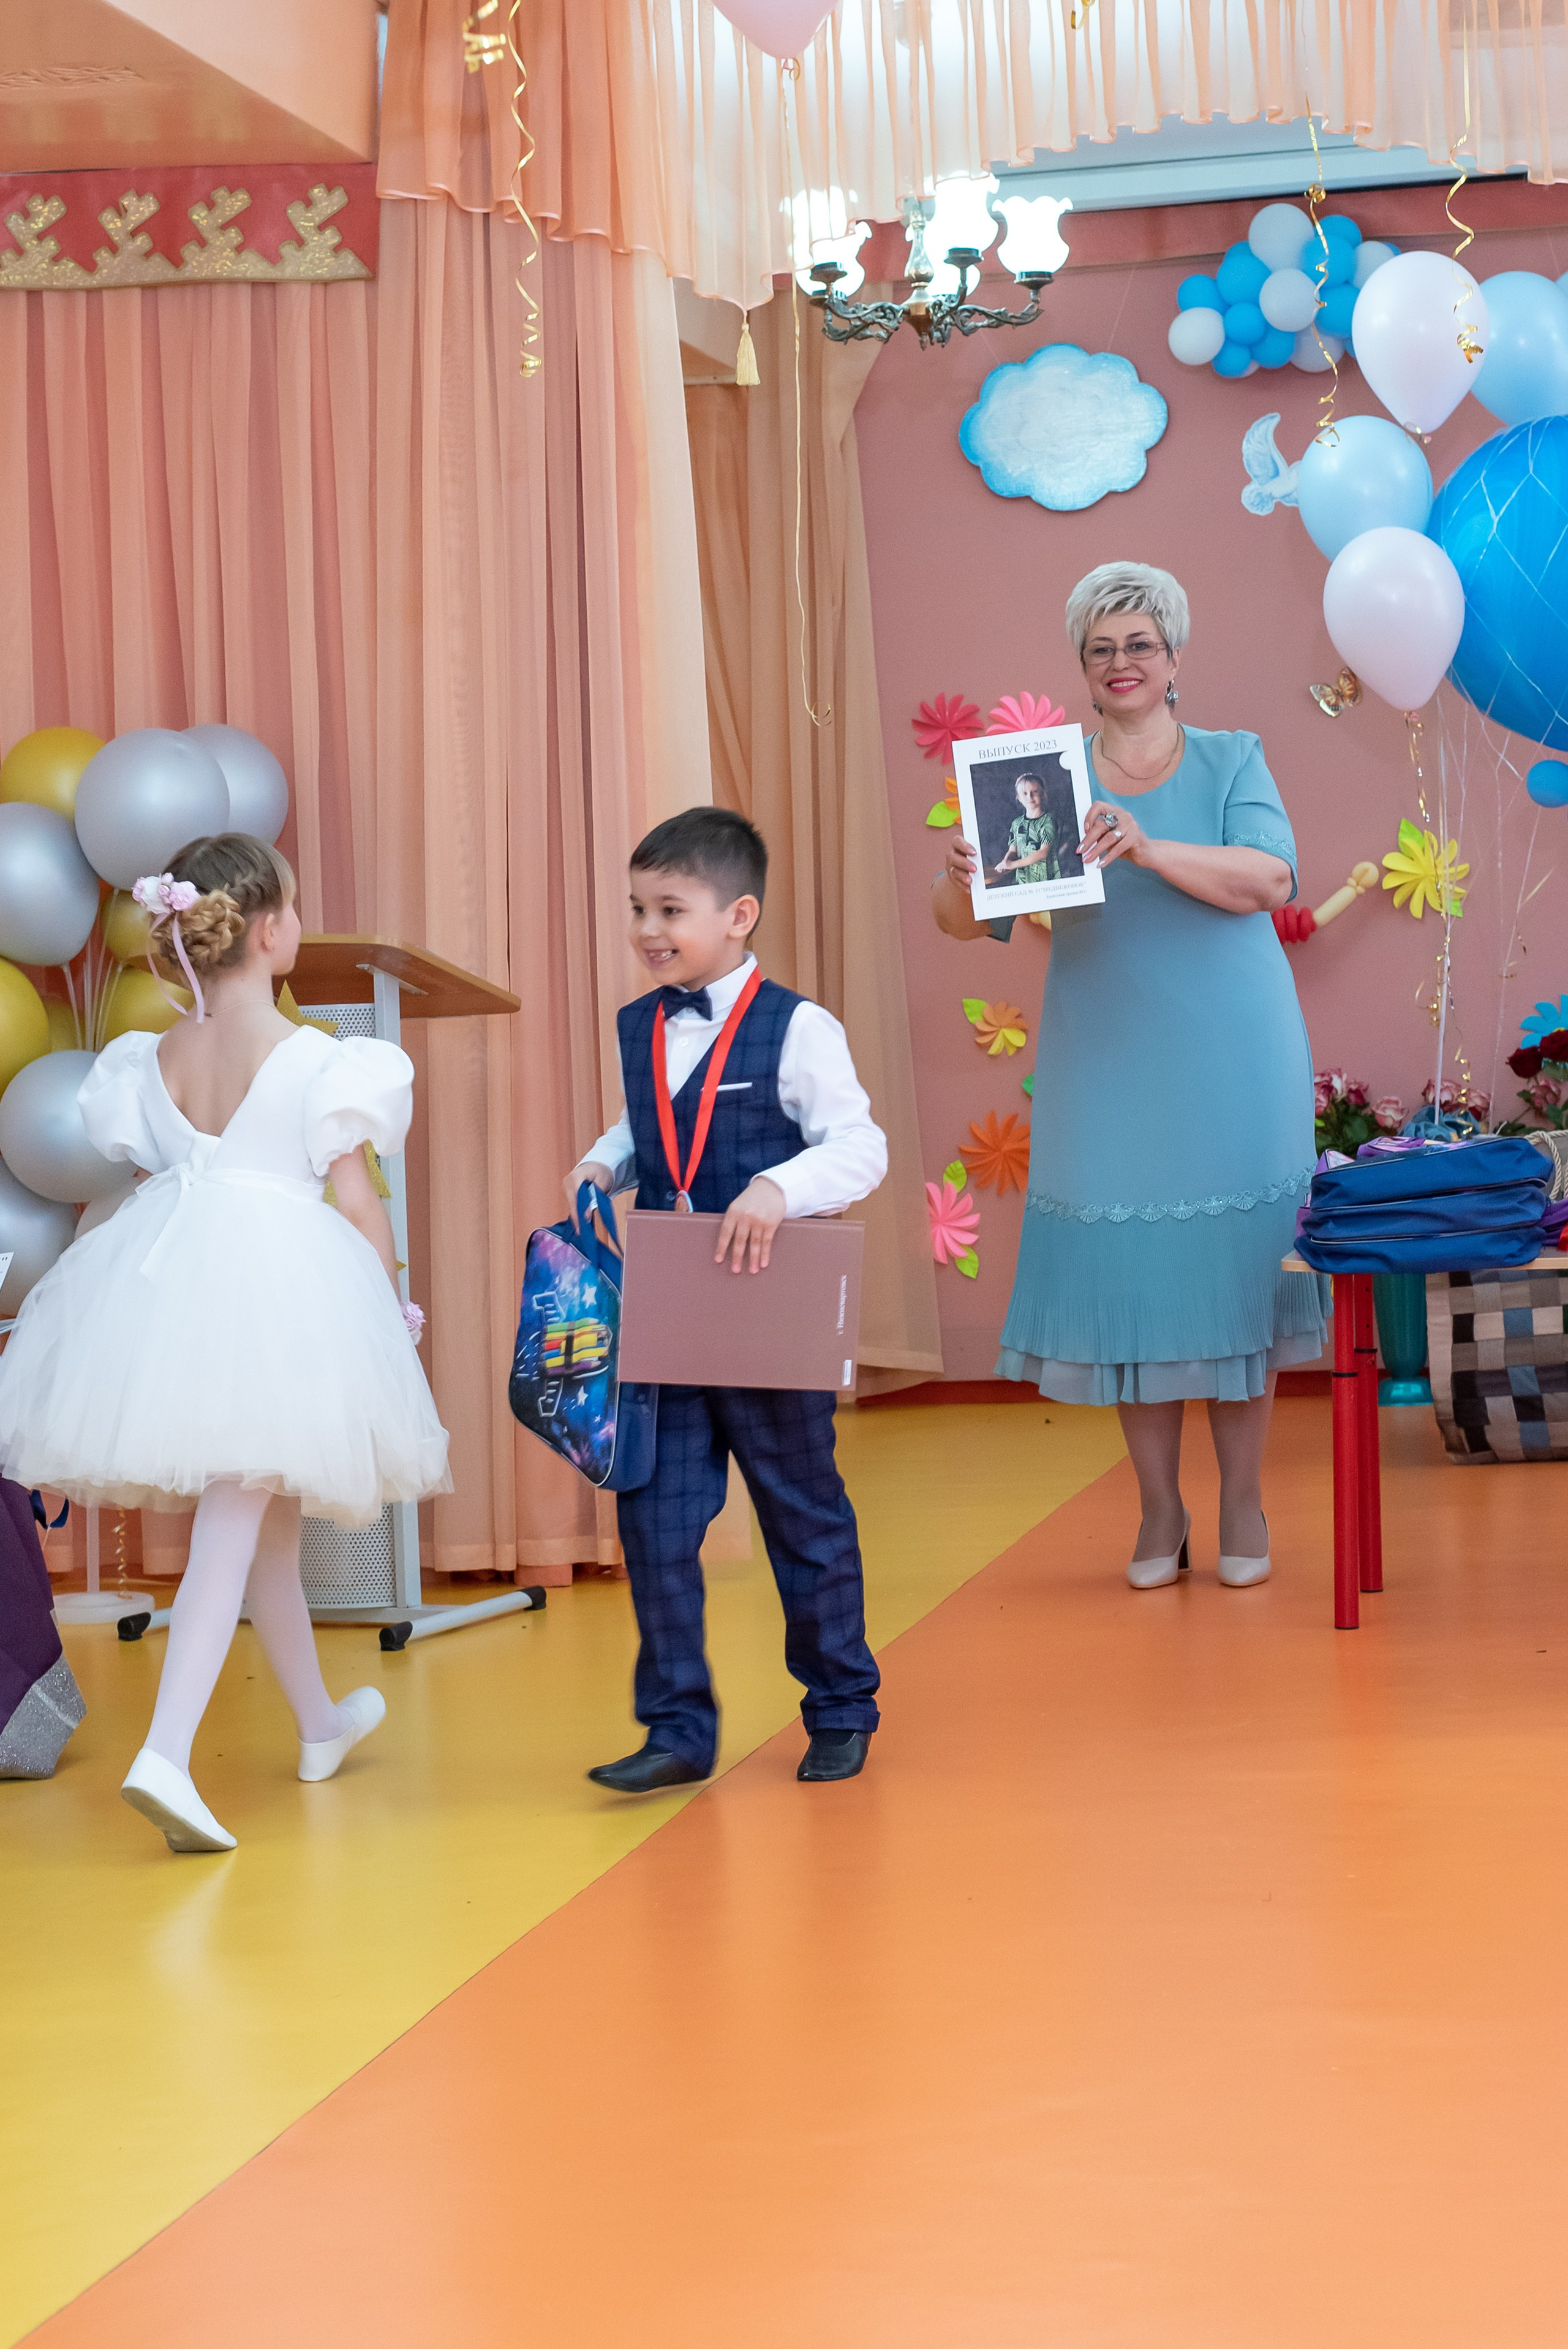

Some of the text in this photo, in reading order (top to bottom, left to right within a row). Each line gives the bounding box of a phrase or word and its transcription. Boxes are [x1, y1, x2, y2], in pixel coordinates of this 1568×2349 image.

[979, 740, 1057, 758] ВЫПУСК 2023
[987, 892, 1014, 901] ДЕТСКИЙ
[837, 1275, 847, 1328] Нижневартовск
